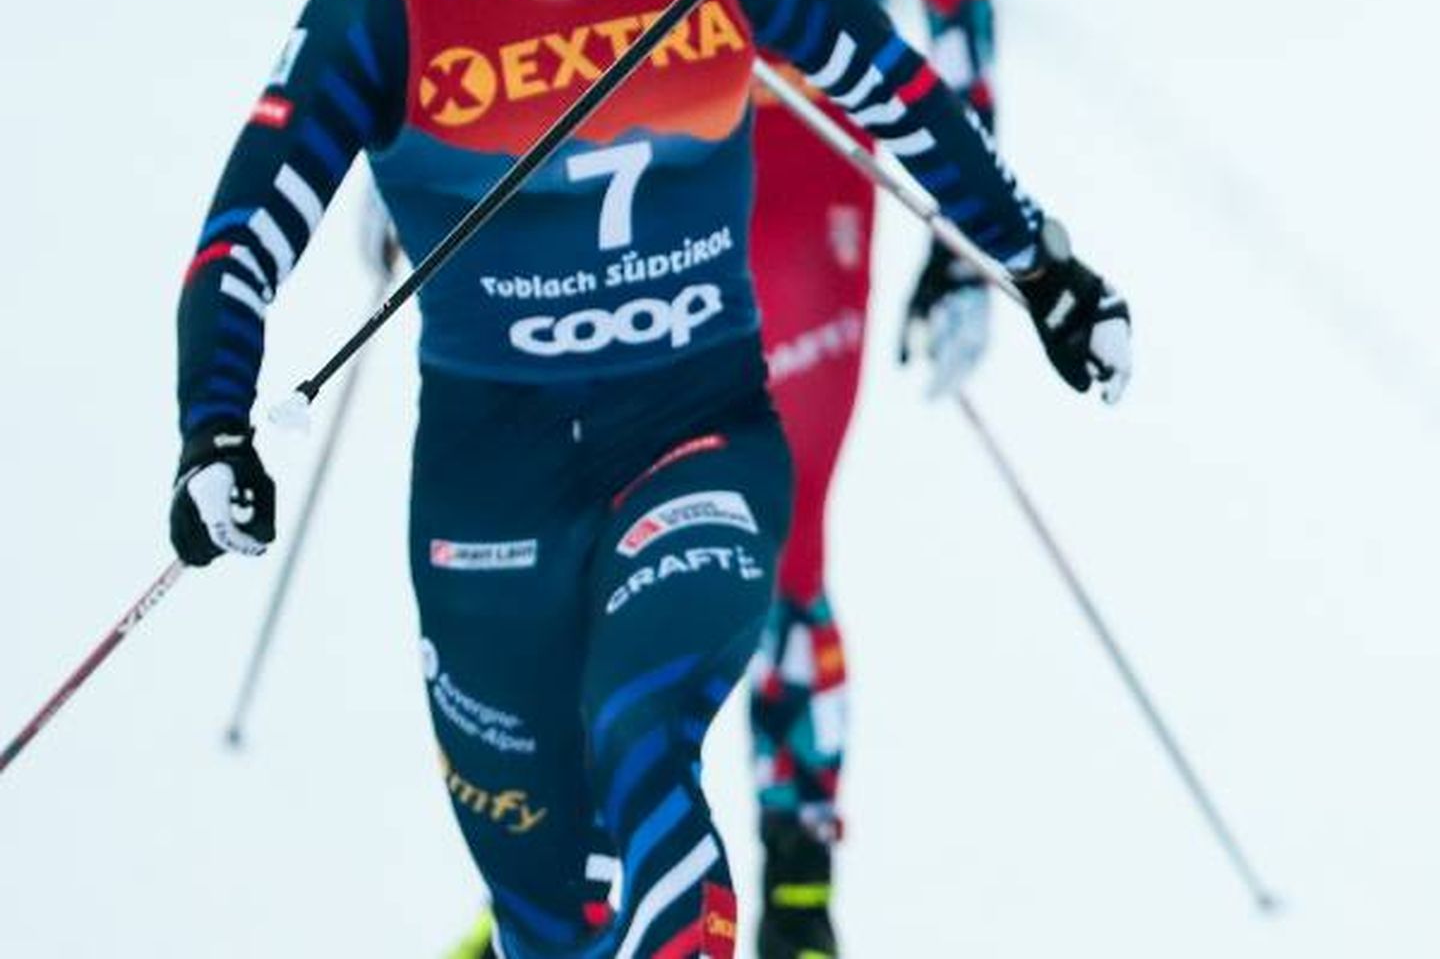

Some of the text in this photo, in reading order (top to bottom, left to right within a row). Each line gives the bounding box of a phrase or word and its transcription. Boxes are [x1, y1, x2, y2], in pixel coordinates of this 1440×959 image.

[499, 0, 746, 103] EXTRA
[566, 140, 653, 251] 7
[479, 271, 597, 299] Toblach
[508, 284, 724, 356] coop
[606, 546, 734, 615] CRAFT
[437, 753, 548, 833] mfy
